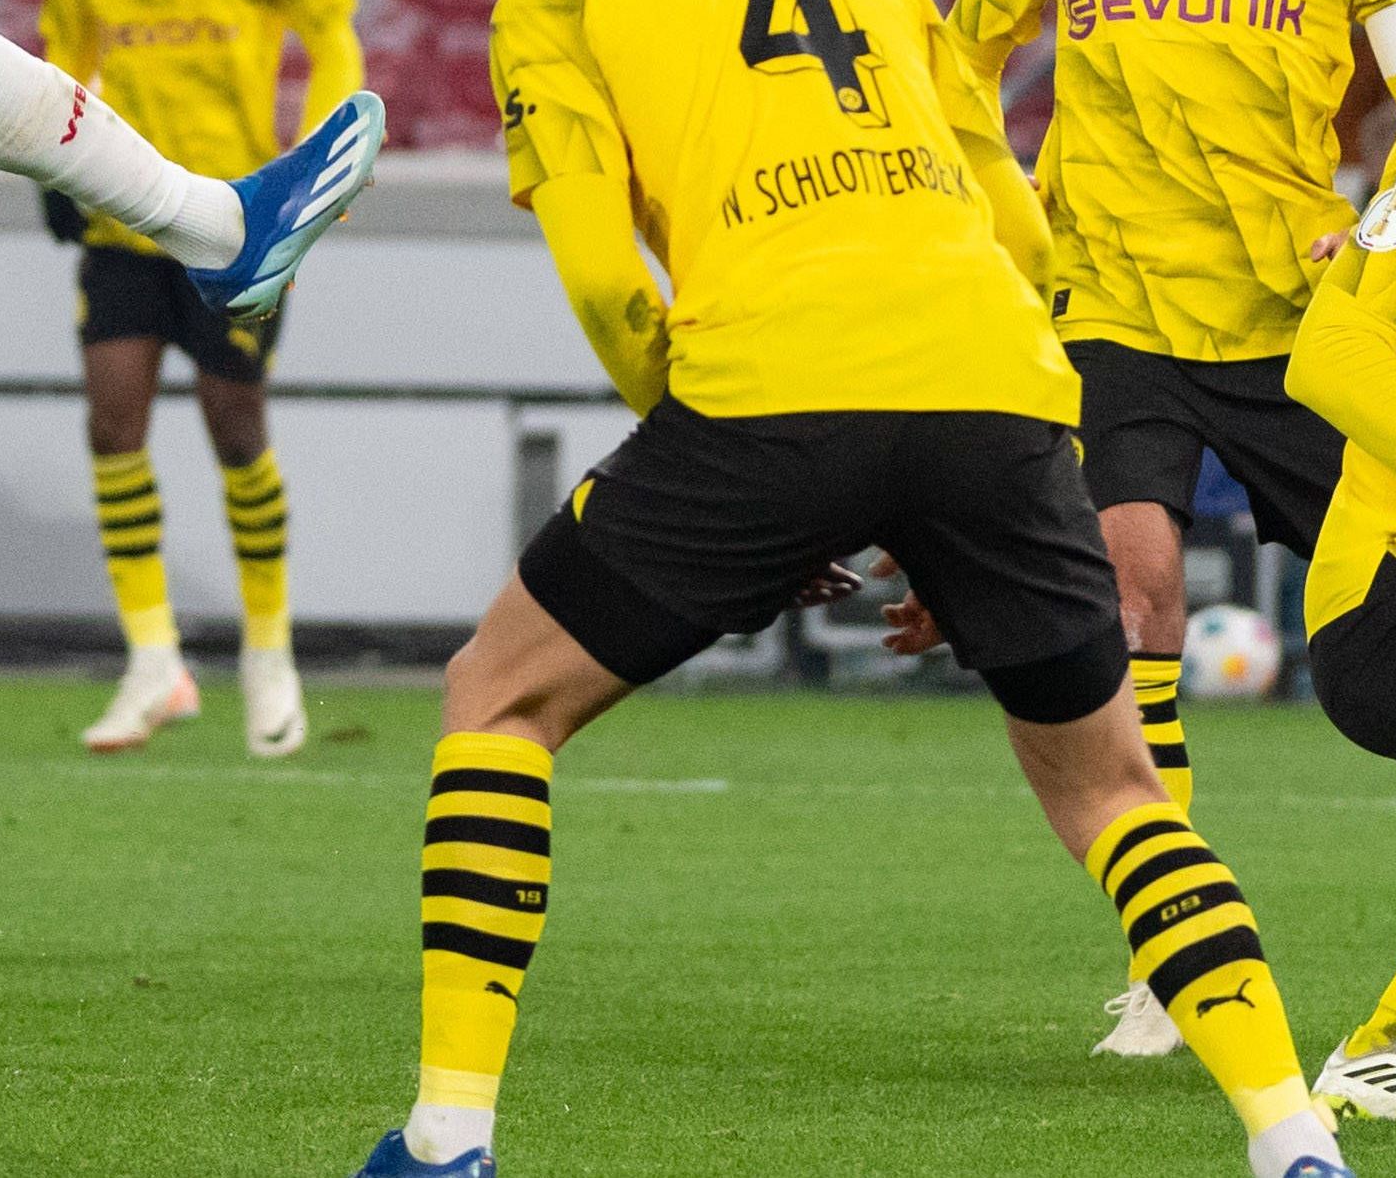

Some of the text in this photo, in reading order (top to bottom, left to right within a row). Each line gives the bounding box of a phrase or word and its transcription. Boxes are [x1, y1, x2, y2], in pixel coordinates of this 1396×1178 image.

[722, 184, 754, 229] N.
[515, 889, 541, 904] 19
[1161, 895, 1201, 922] 09
